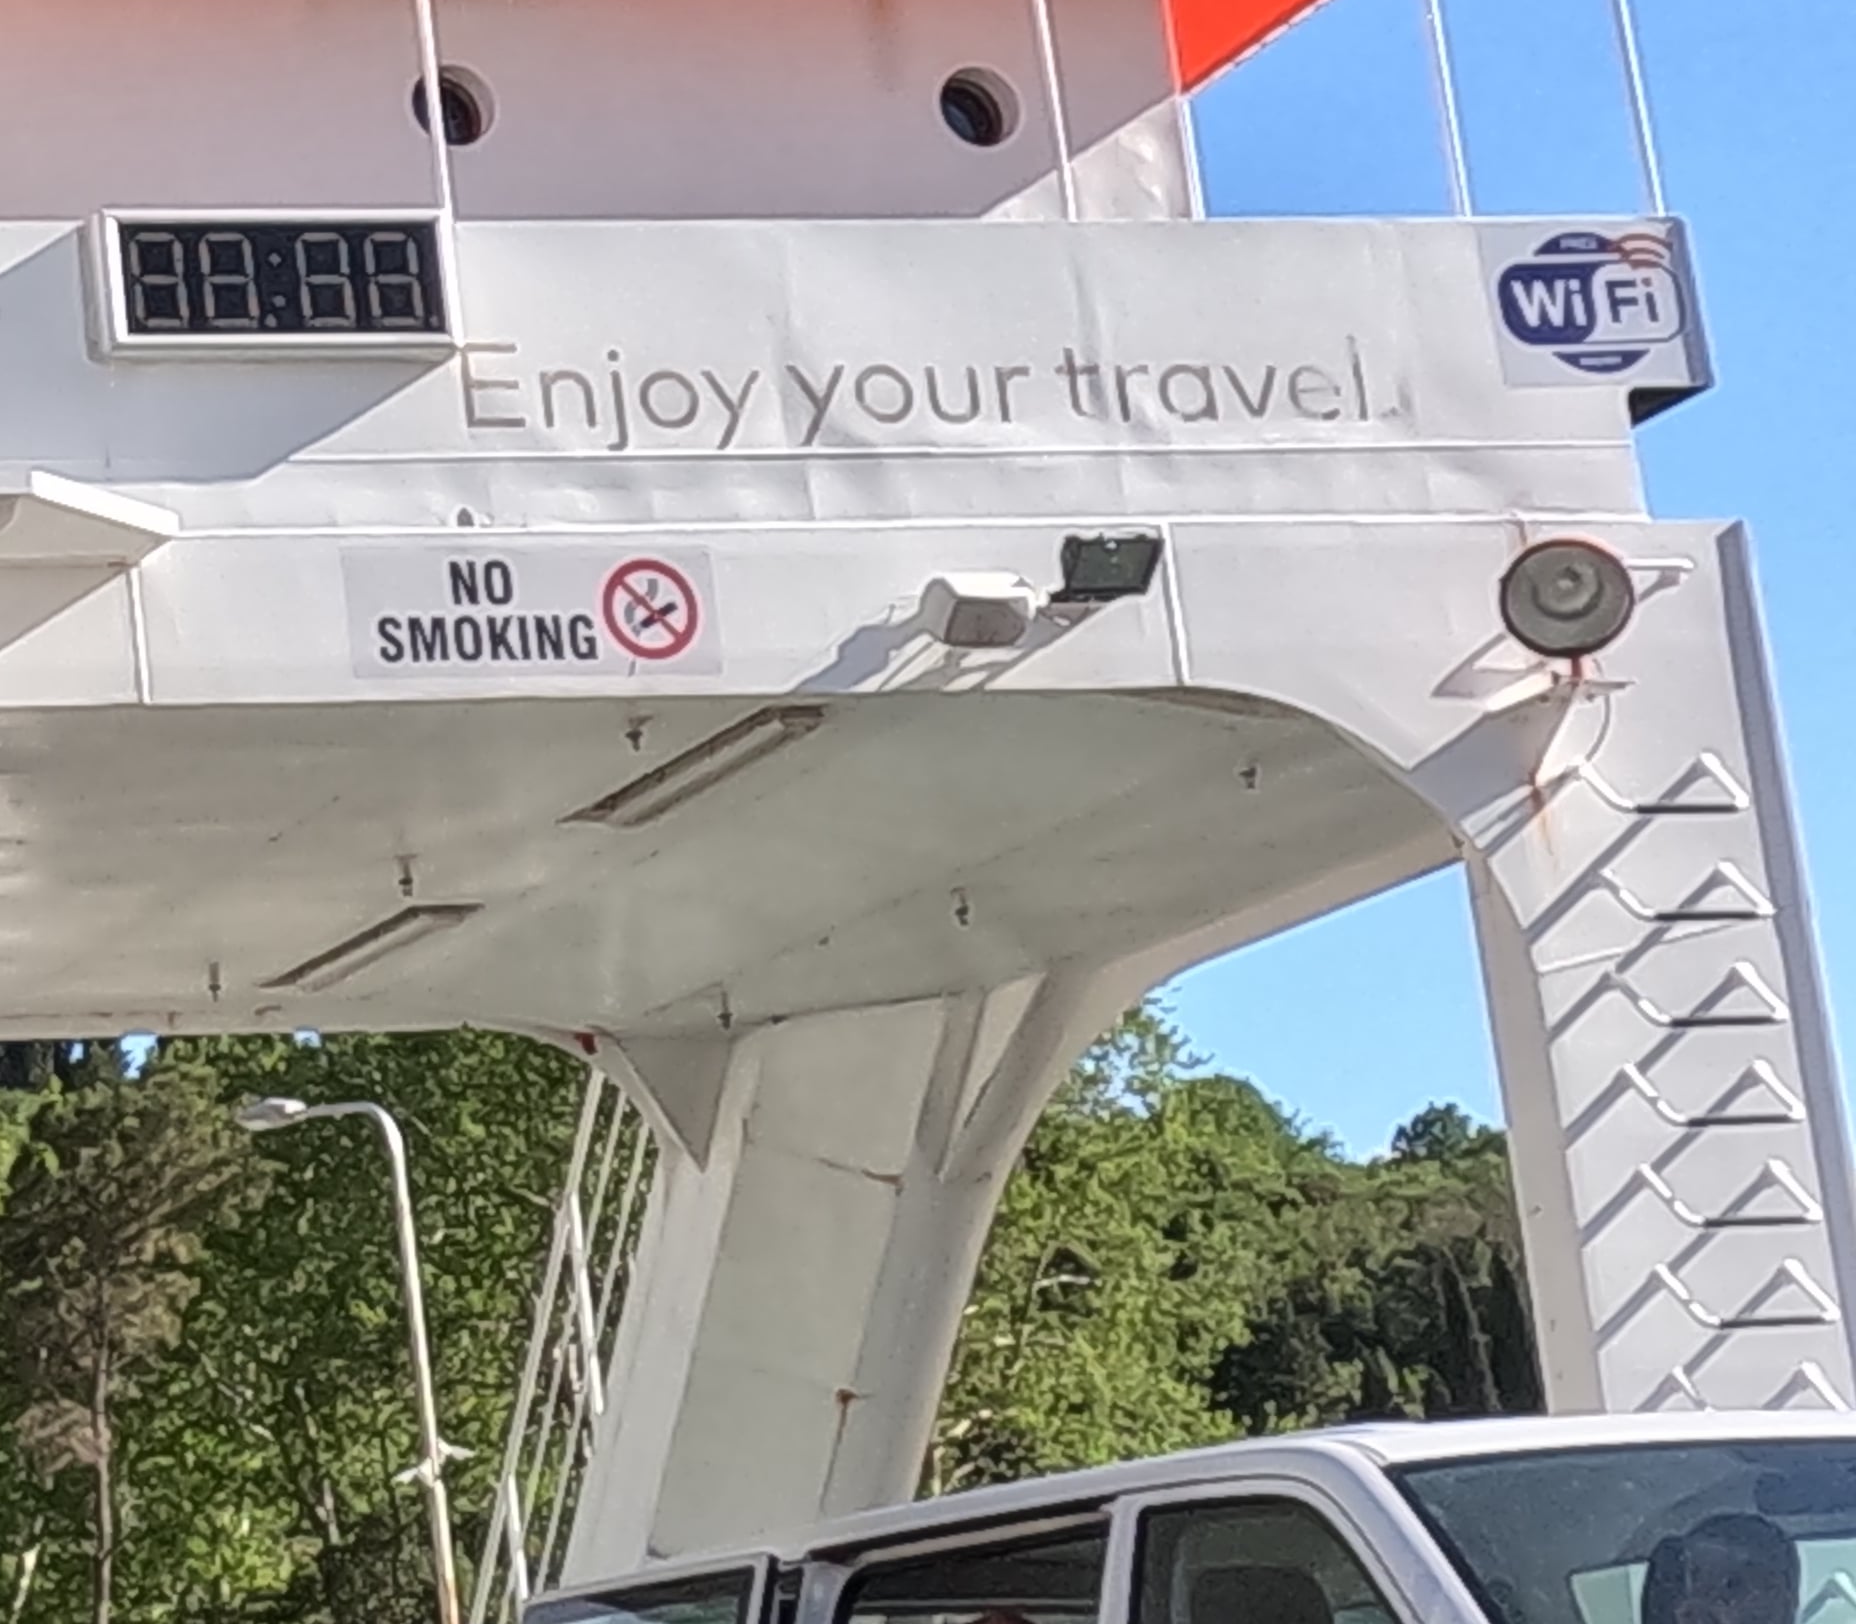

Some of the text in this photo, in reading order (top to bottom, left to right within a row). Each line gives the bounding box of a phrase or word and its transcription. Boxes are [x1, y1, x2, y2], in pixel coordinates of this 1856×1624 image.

[459, 341, 761, 452] Enjoy
[784, 363, 1032, 447] your
[448, 559, 514, 606] NO
[377, 614, 600, 663] SMOKING
